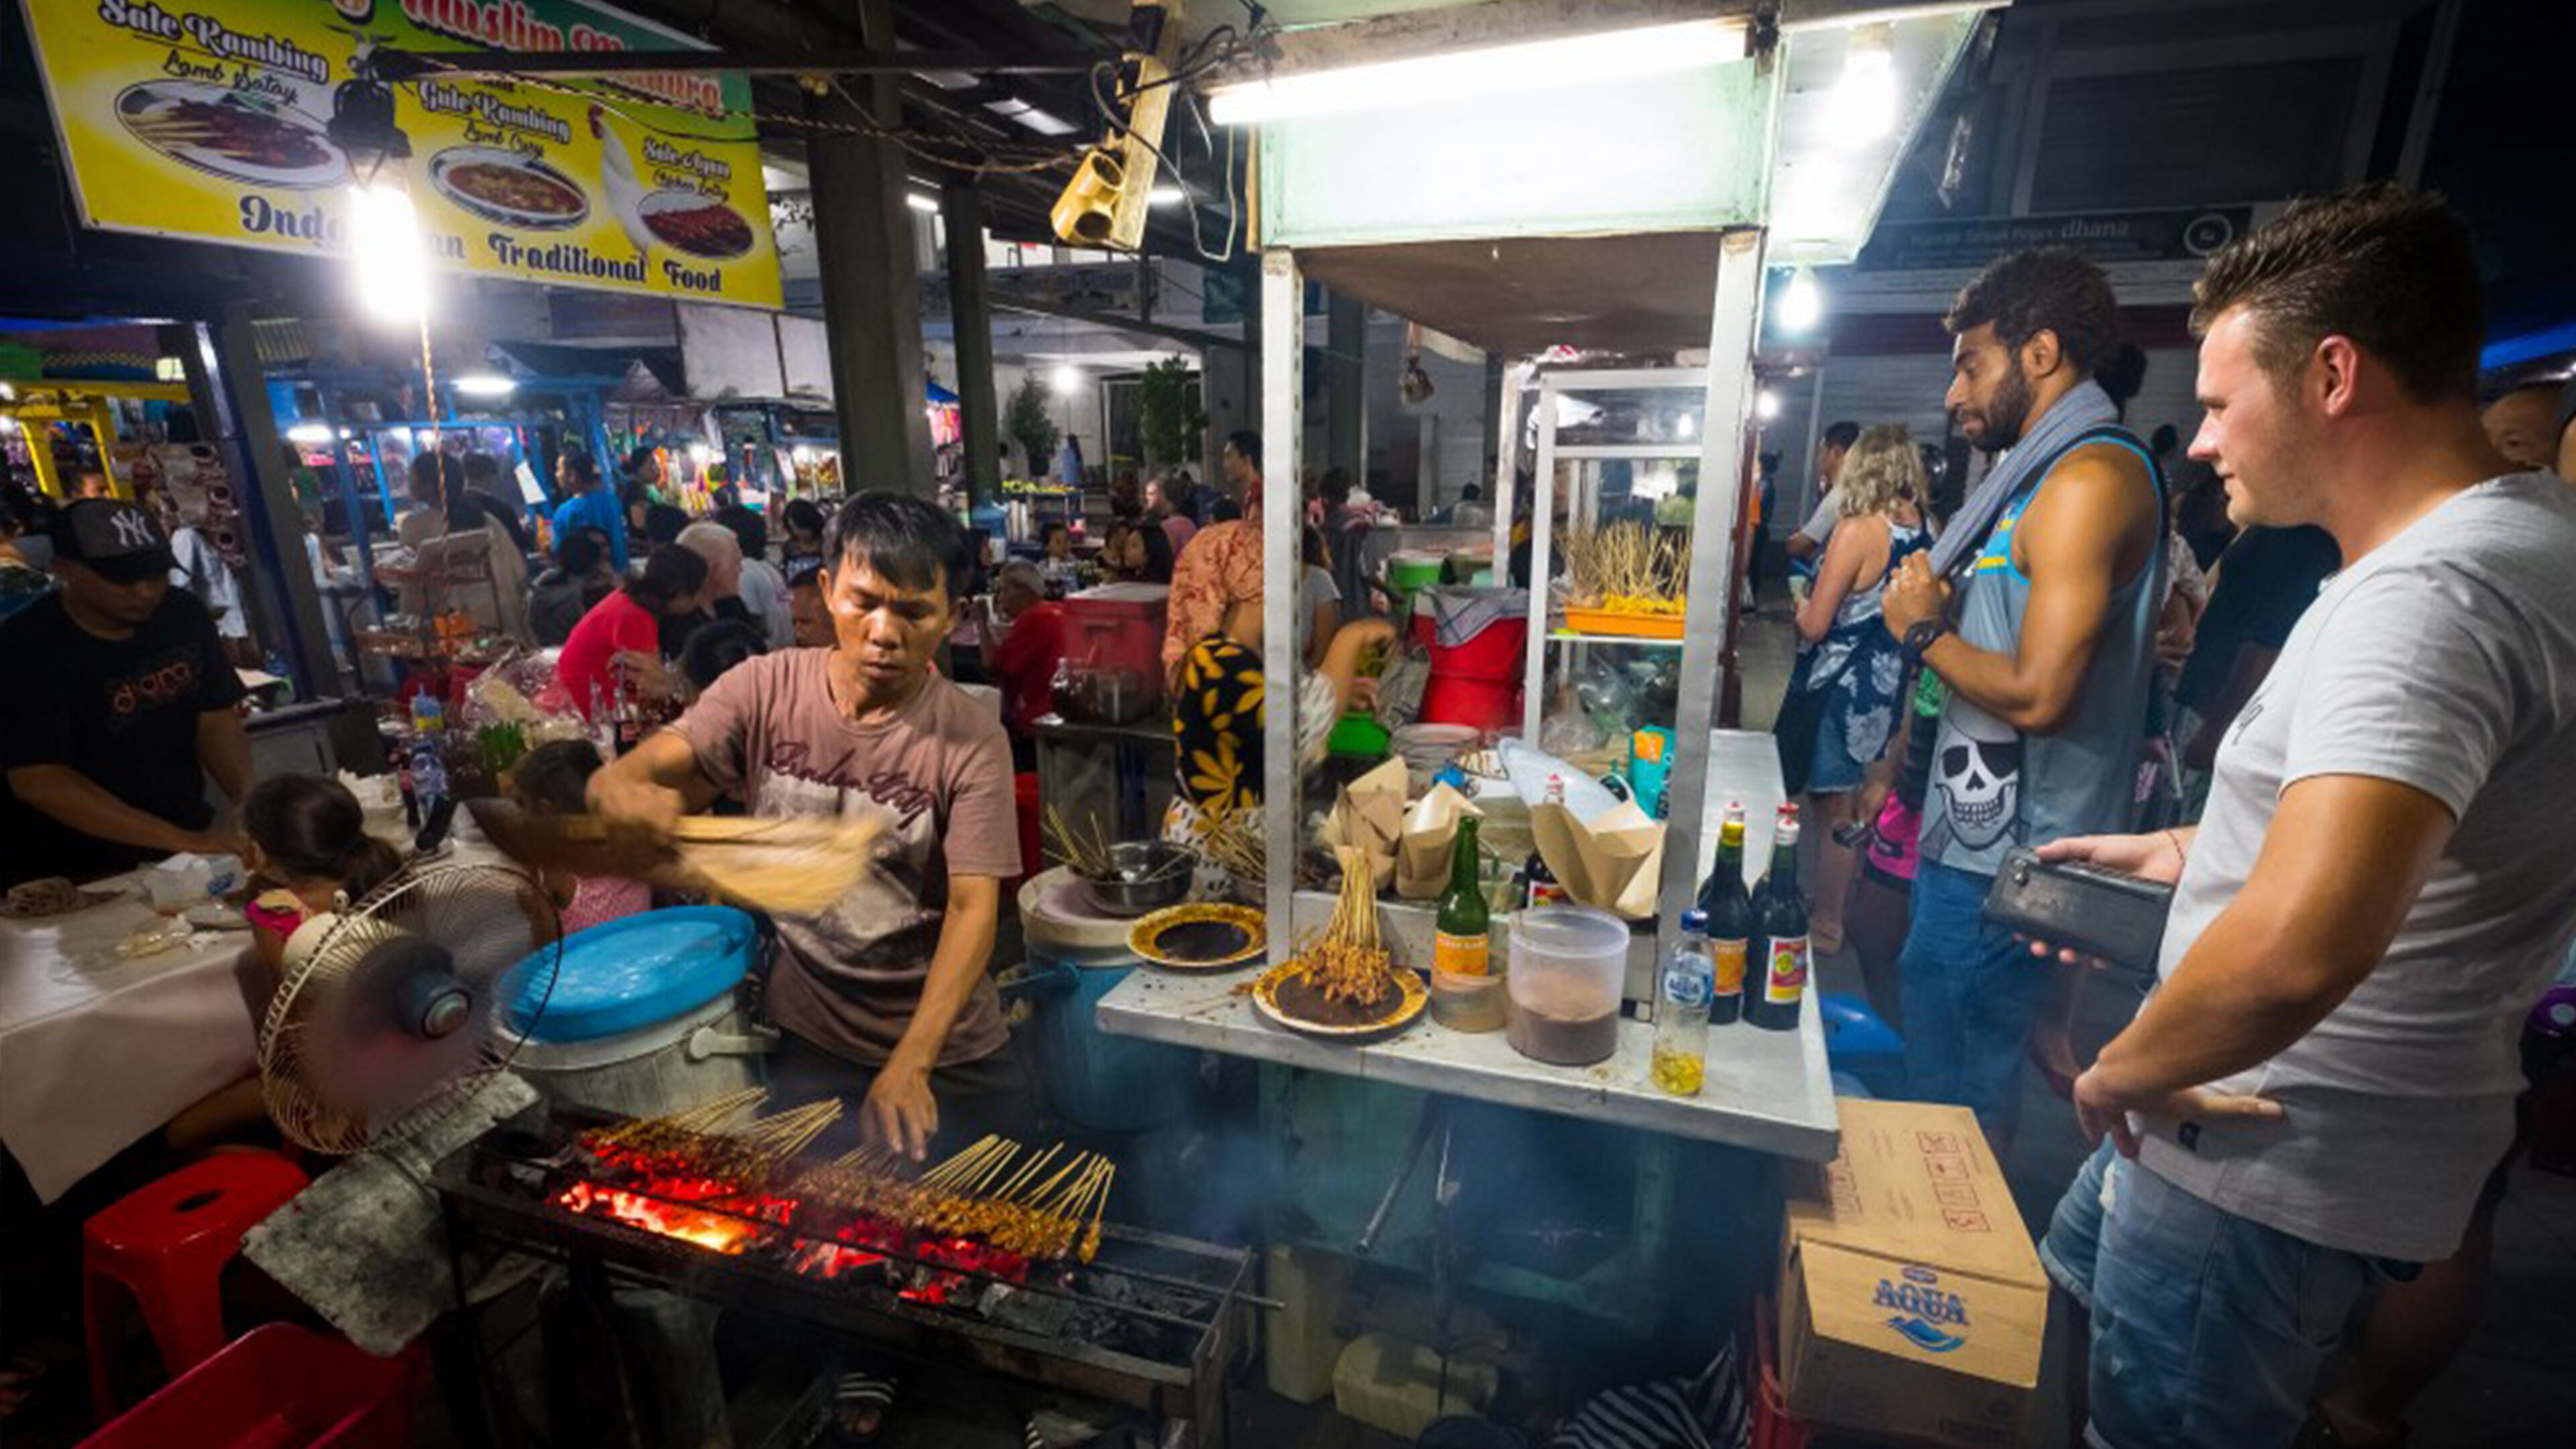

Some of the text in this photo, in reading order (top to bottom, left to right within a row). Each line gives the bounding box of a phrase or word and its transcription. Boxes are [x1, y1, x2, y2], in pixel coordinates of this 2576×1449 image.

[162, 49, 298, 105] Lamb Satay
[182, 12, 329, 85] Kambing
[418, 79, 571, 146] Gule Kambing
[488, 232, 647, 283] Traditional
[663, 260, 721, 292] Food
[1872, 1277, 1971, 1326] AQUA
